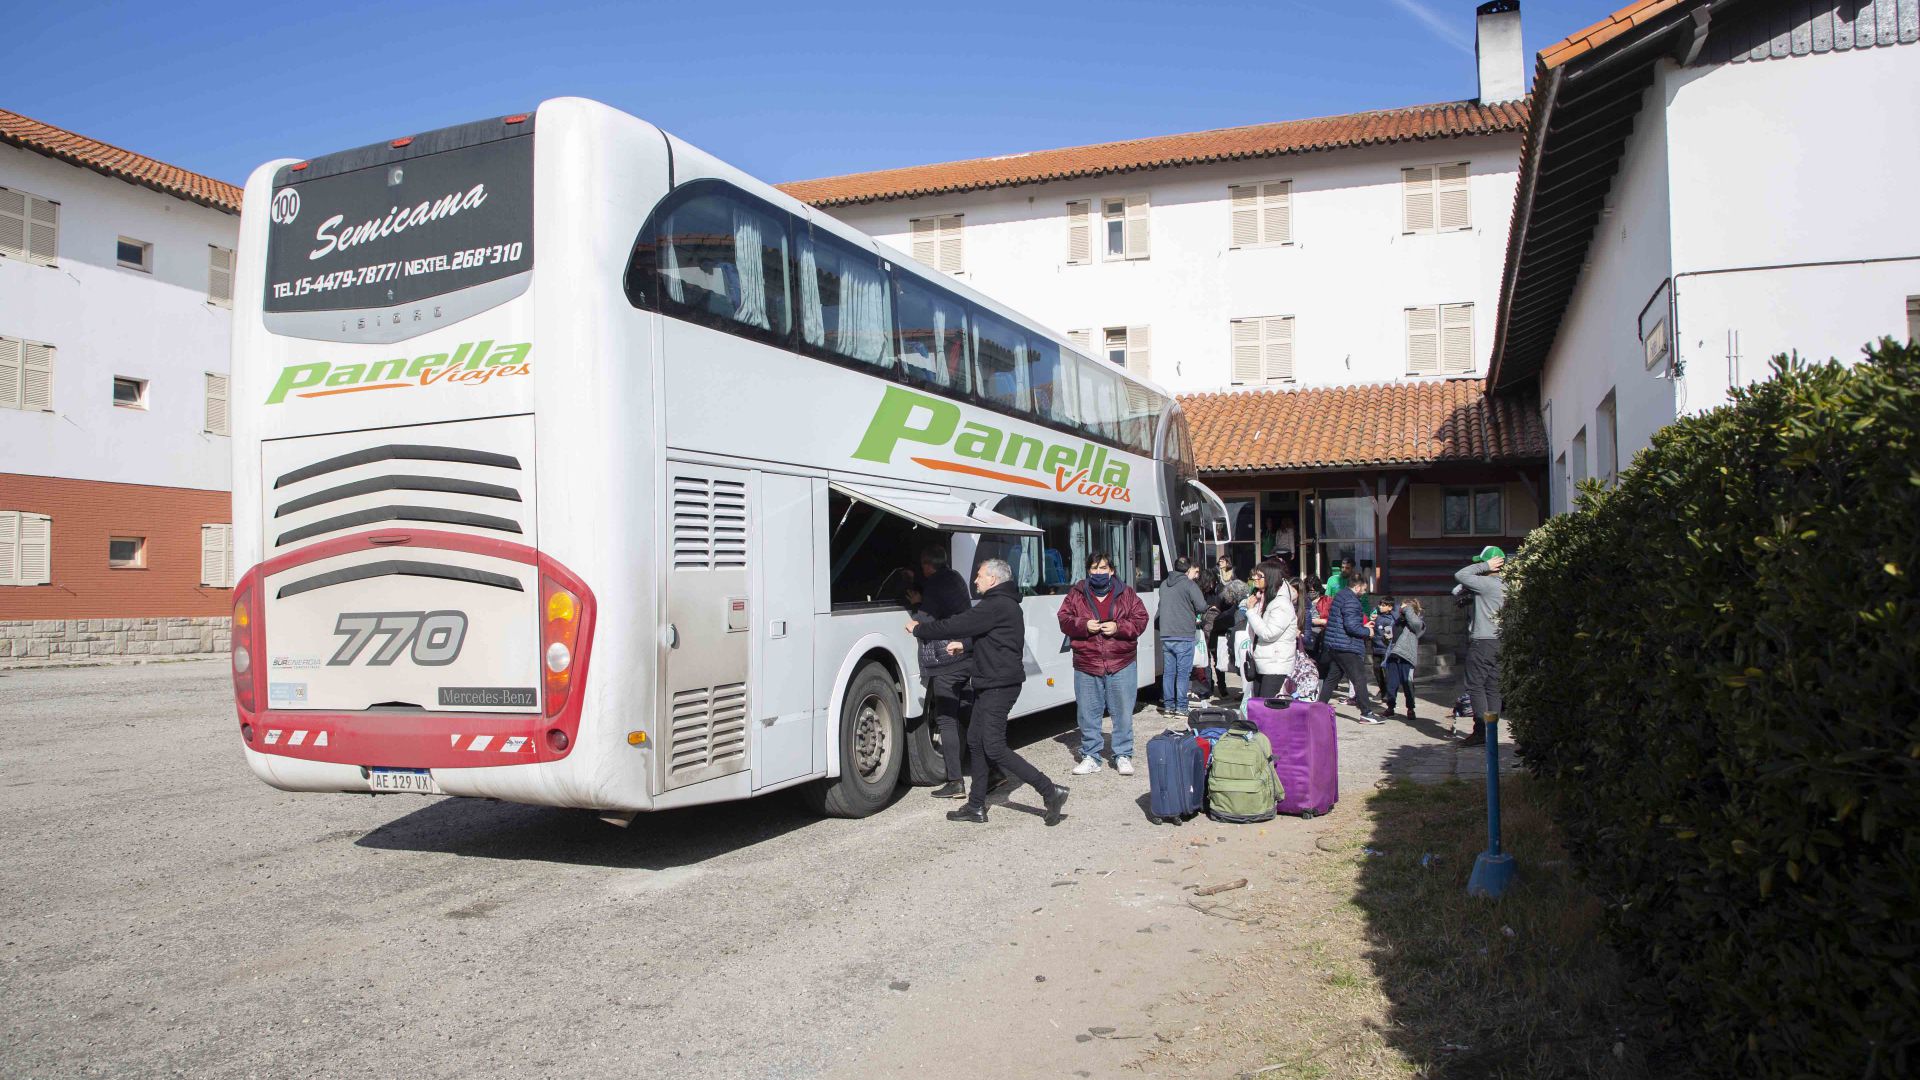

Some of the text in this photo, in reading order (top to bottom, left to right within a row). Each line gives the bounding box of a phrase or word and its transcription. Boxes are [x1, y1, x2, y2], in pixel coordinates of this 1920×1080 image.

[274, 193, 298, 220] 100
[309, 183, 488, 260] Semicama
[273, 283, 294, 299] TEL
[405, 255, 451, 276] NEXTEL
[264, 340, 533, 405] Panella
[420, 361, 532, 386] Viajes
[851, 385, 1131, 489] Panella
[1055, 466, 1132, 505] Viajes
[326, 609, 469, 666] 770
[443, 689, 532, 704] Mercedes-Benz
[376, 775, 429, 790] AE 129 VX
